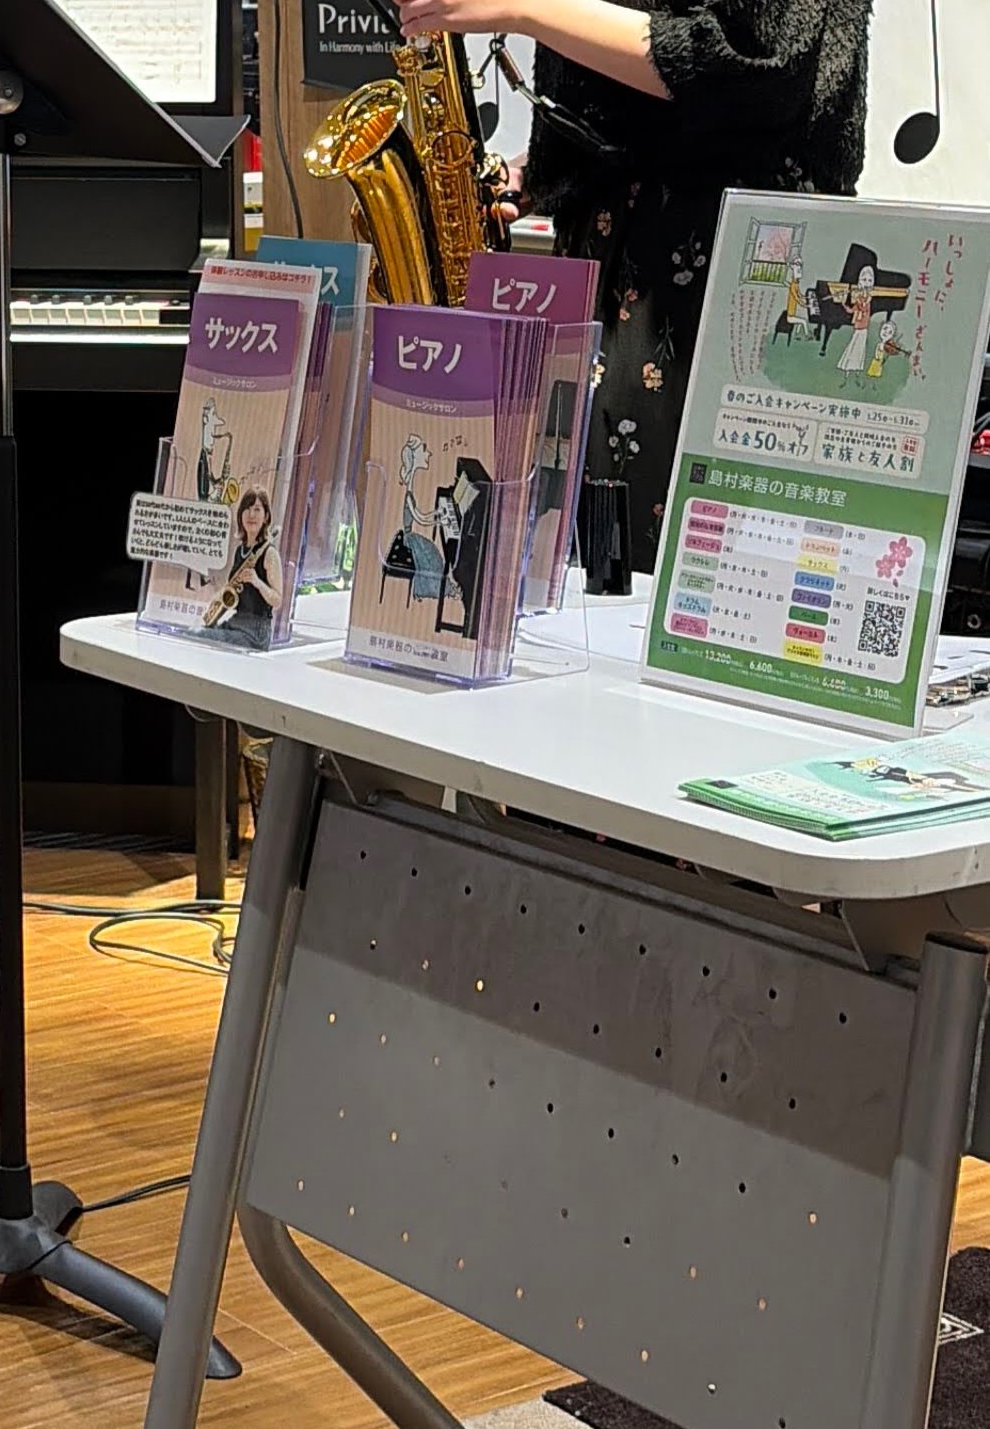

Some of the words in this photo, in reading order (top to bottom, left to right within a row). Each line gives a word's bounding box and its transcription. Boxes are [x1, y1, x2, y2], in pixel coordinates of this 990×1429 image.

[319, 41, 328, 52] In
[329, 41, 365, 55] Harmony
[366, 41, 384, 52] with
[492, 278, 556, 313] ピアノ
[205, 317, 277, 353] サックス
[398, 335, 462, 373] ピアノ
[822, 443, 914, 472] 家族と友人割
[709, 469, 847, 507] 島村楽器の音楽教室
